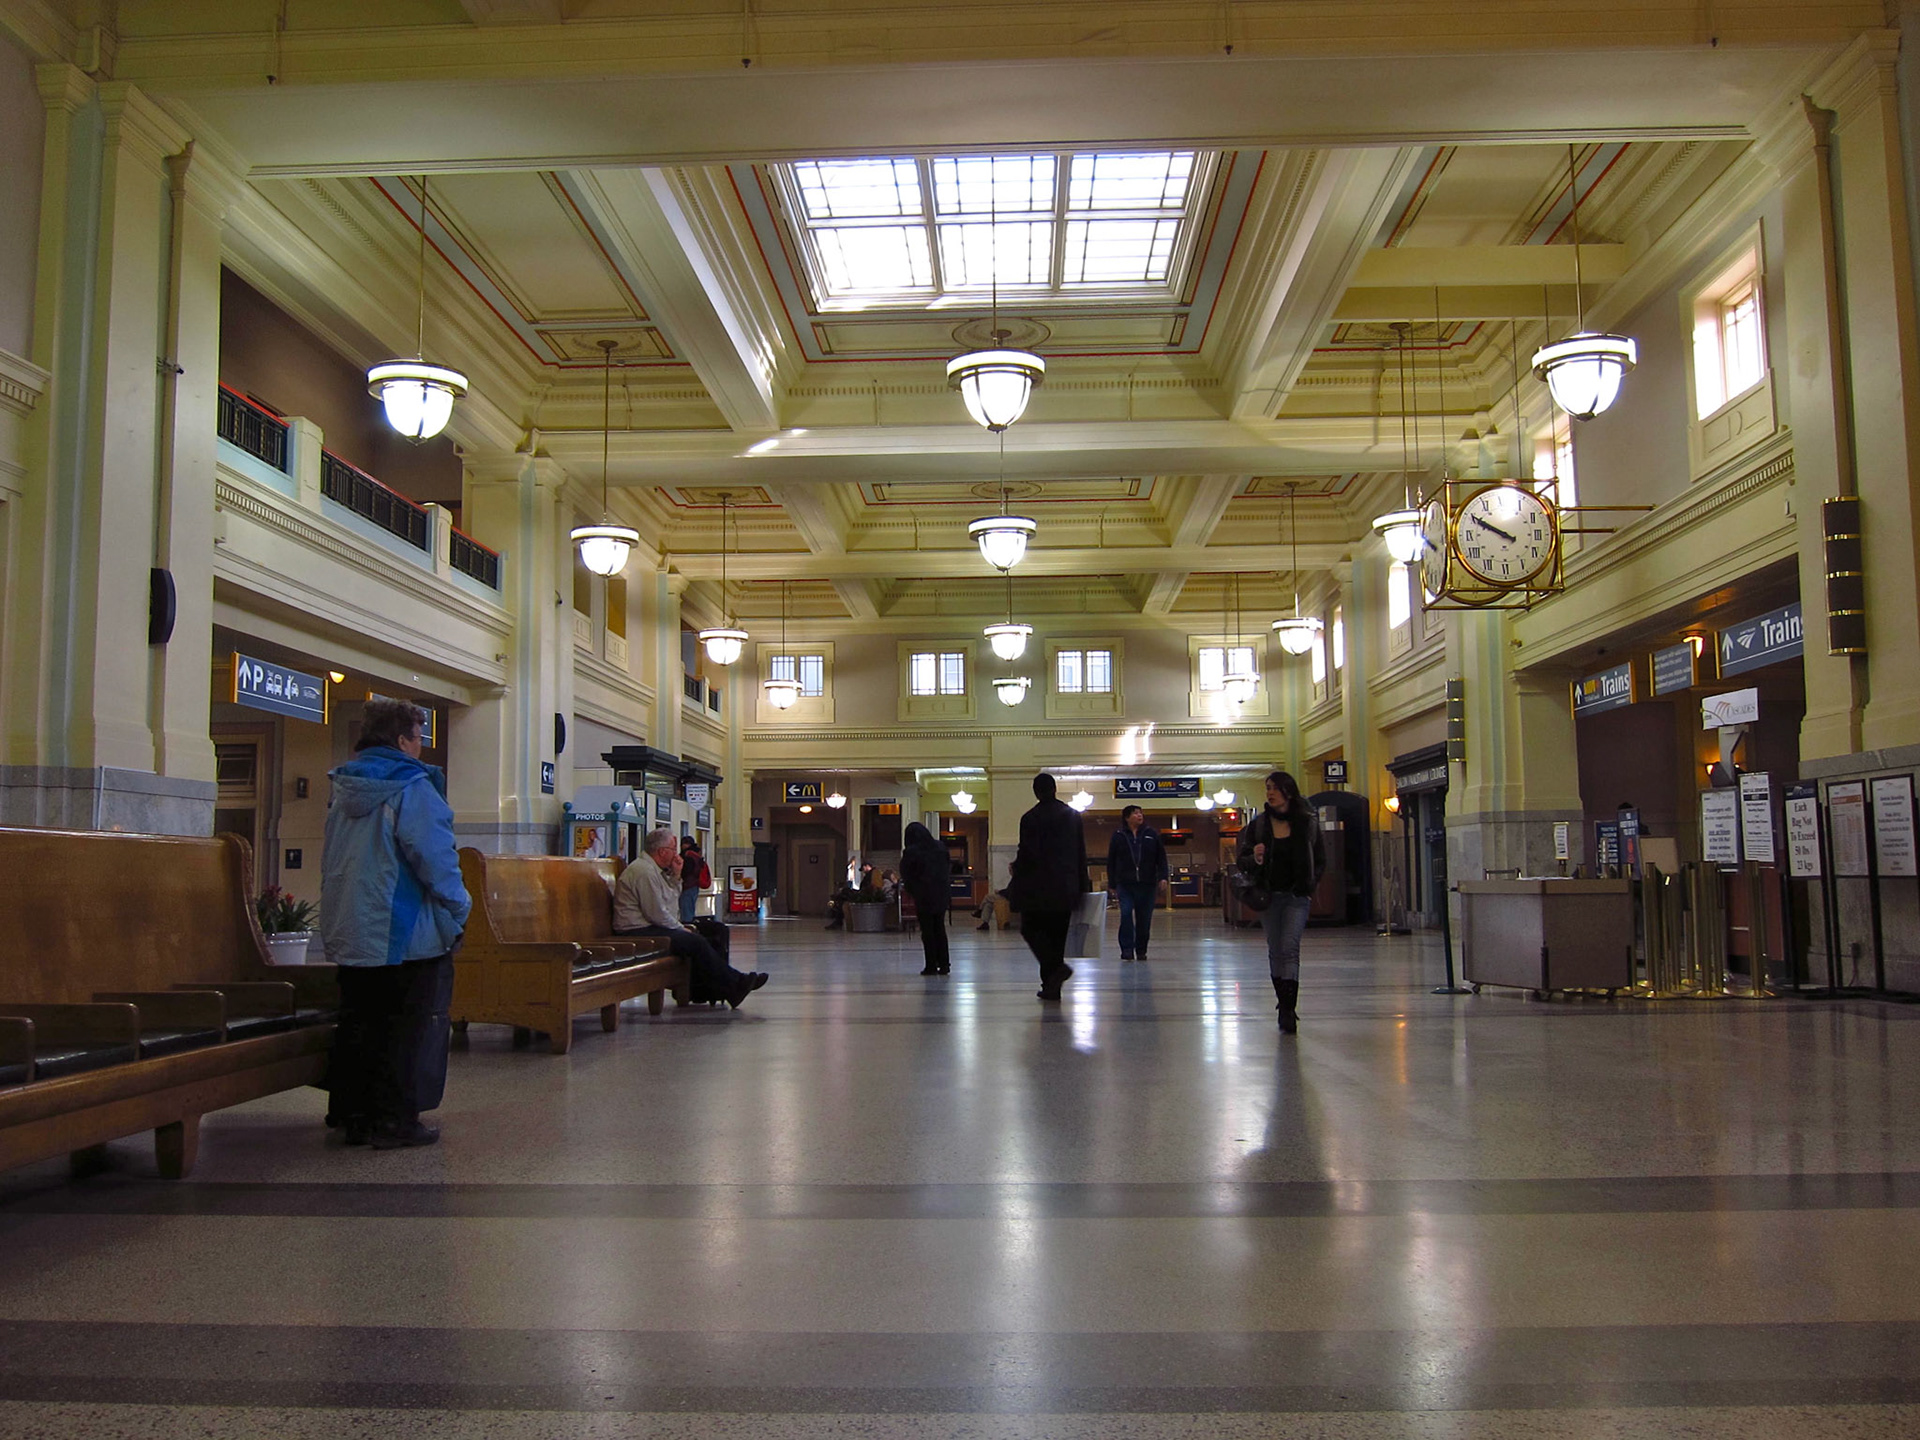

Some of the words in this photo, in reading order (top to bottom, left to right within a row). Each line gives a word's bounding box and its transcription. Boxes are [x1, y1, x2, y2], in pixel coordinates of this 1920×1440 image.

[253, 664, 264, 691] P
[1600, 671, 1630, 697] Trains
[1430, 766, 1446, 780] LOUNGE
[1794, 802, 1807, 812] Each
[1792, 817, 1802, 828] Bag
[1803, 816, 1812, 826] Not
[1790, 831, 1797, 841] To
[1798, 831, 1816, 841] Exceed
[1802, 845, 1810, 855] lbs
[1797, 860, 1804, 869] 23
[1804, 860, 1813, 871] kgs
